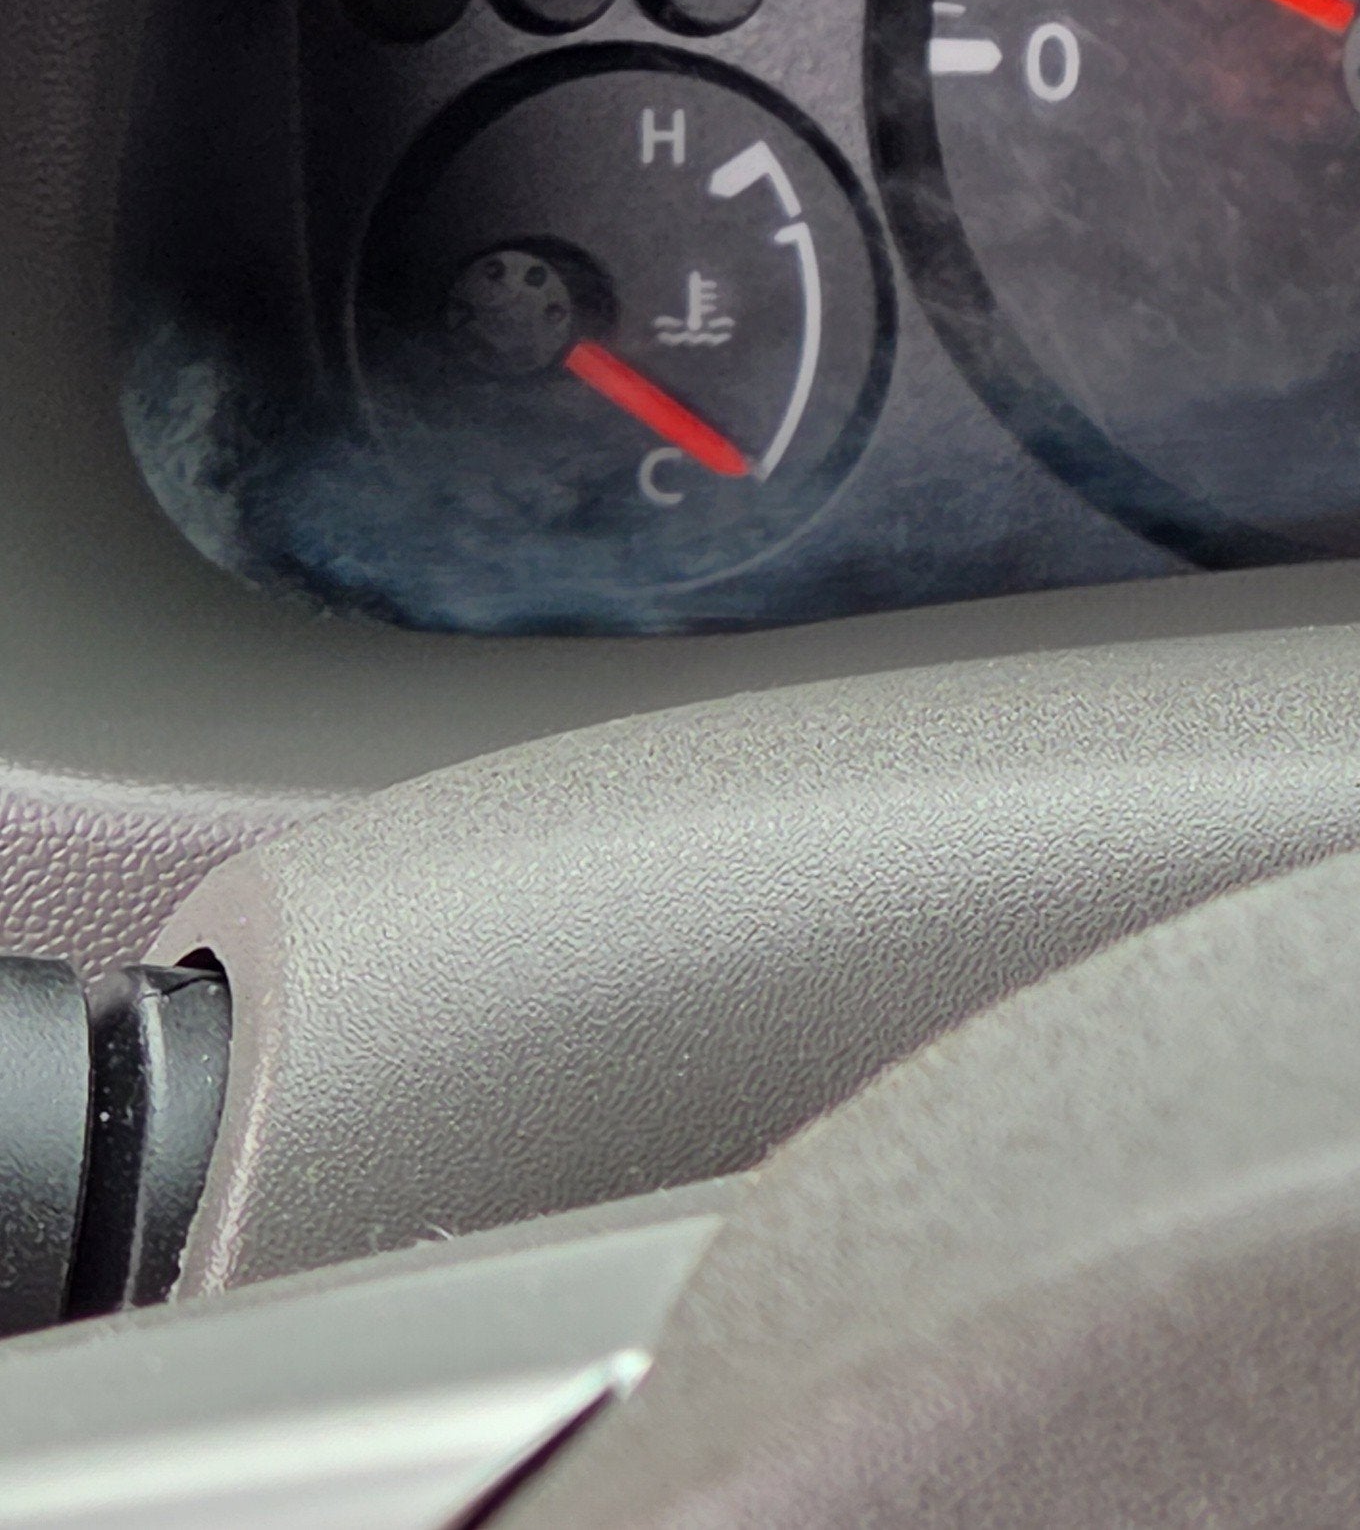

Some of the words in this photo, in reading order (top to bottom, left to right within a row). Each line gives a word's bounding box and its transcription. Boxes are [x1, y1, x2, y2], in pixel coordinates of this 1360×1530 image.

[1025, 22, 1081, 103] 0
[641, 108, 686, 165] H
[641, 447, 684, 504] C
